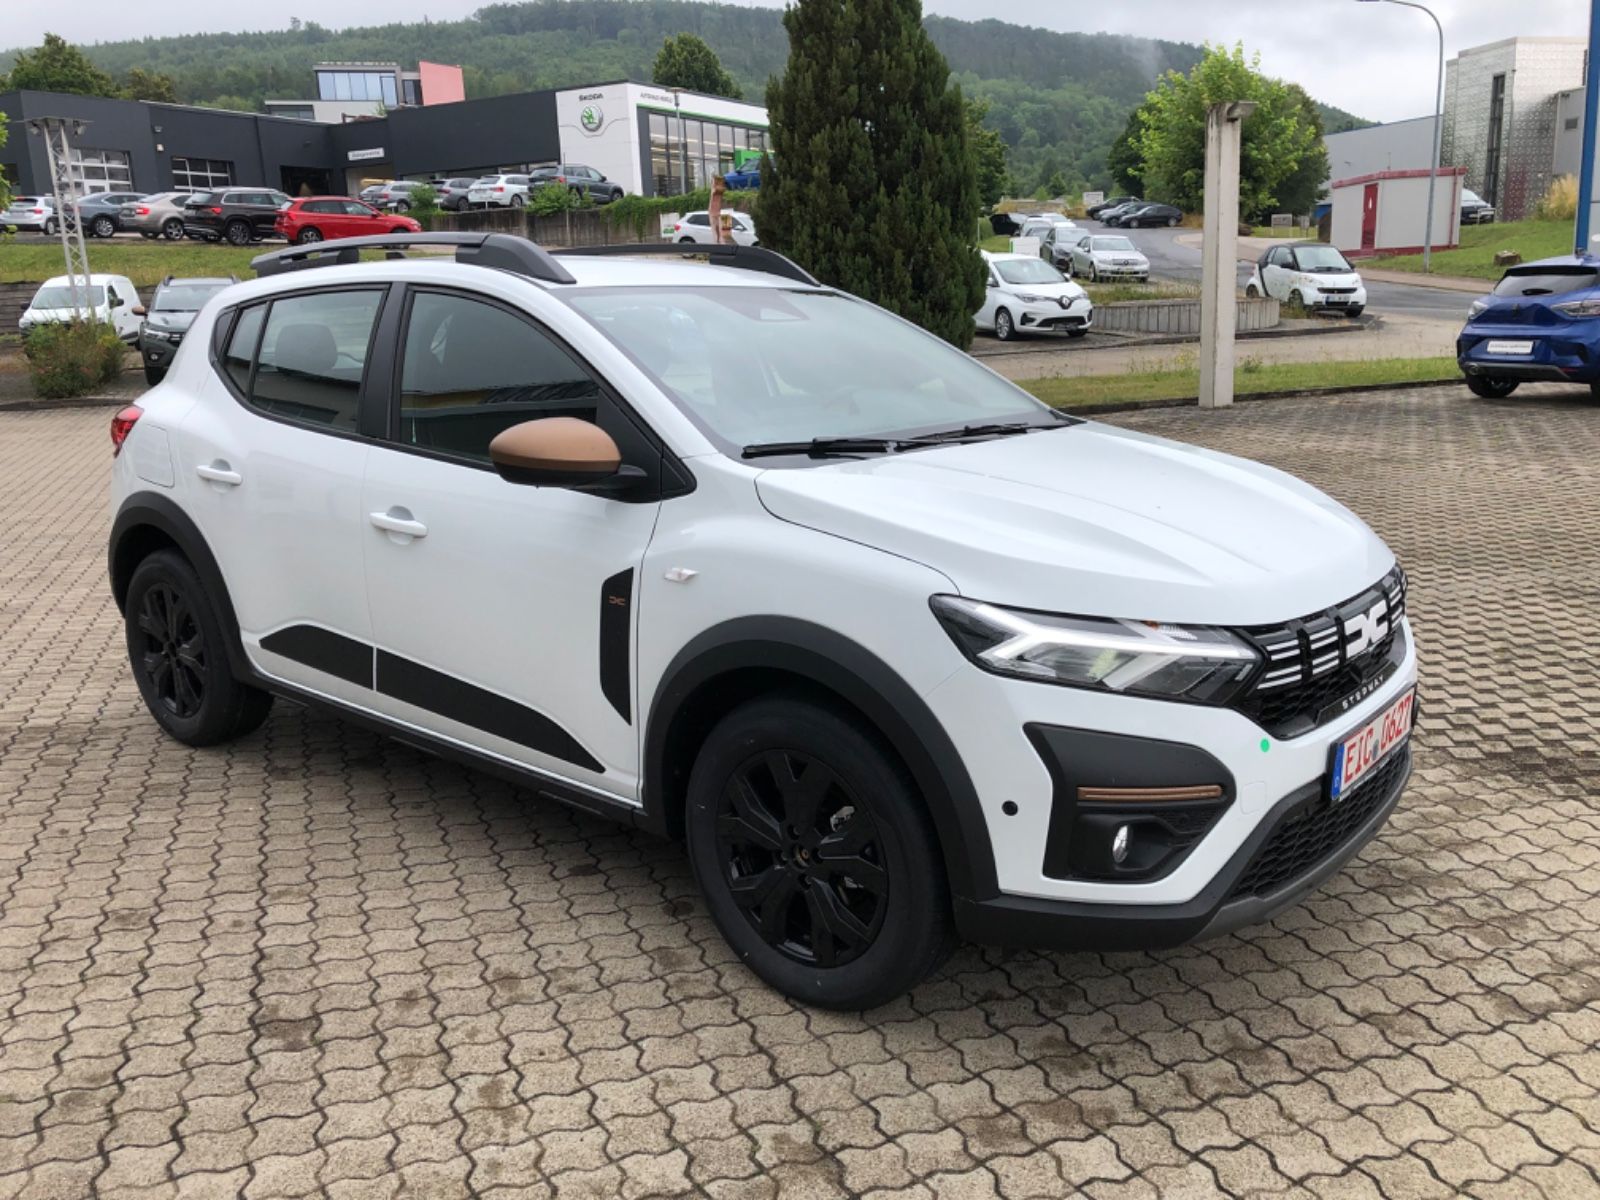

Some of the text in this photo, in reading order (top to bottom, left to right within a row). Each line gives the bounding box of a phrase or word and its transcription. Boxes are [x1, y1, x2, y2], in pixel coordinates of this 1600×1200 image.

[1342, 674, 1384, 709] STEPWAY
[1345, 693, 1412, 784] EIC 0627
